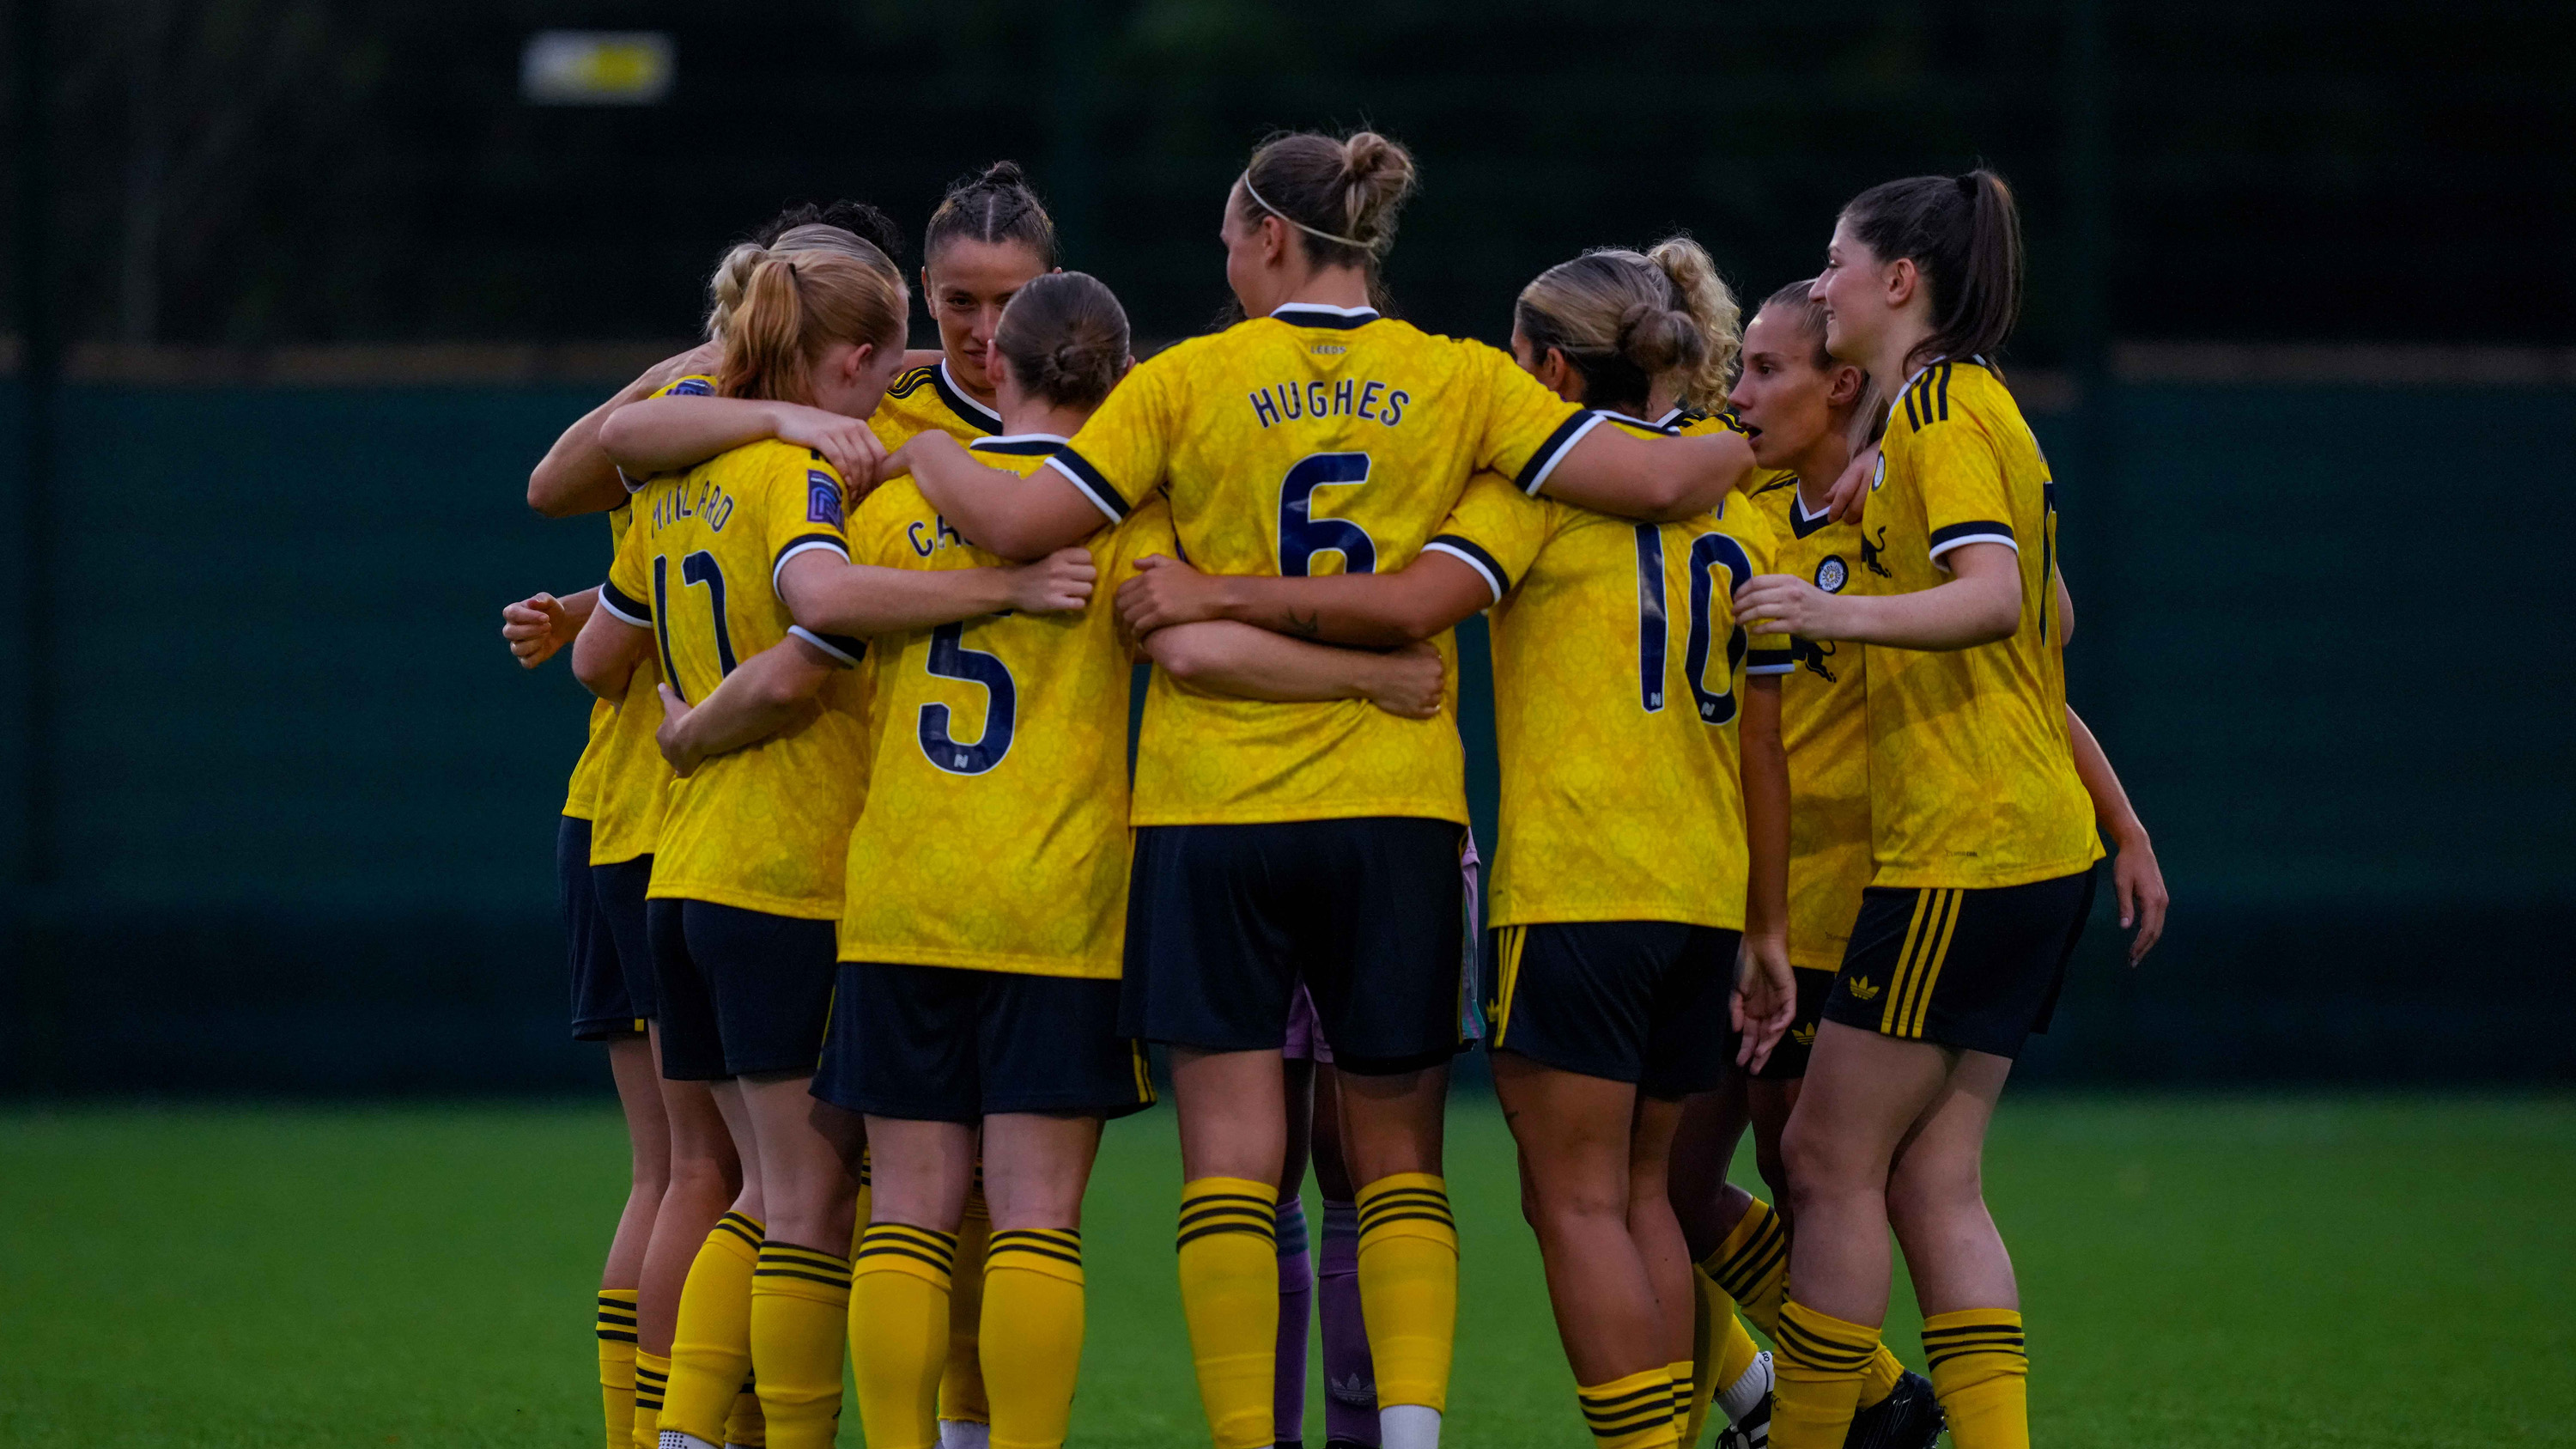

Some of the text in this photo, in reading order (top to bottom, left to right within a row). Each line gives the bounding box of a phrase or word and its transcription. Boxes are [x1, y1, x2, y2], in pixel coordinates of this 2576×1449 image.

[1310, 345, 1347, 355] LEEDS
[1248, 377, 1411, 429] HUGHES
[908, 514, 974, 557] CA
[1278, 451, 1377, 577] 6
[1634, 521, 1753, 726] 10
[917, 607, 1017, 776] 5
